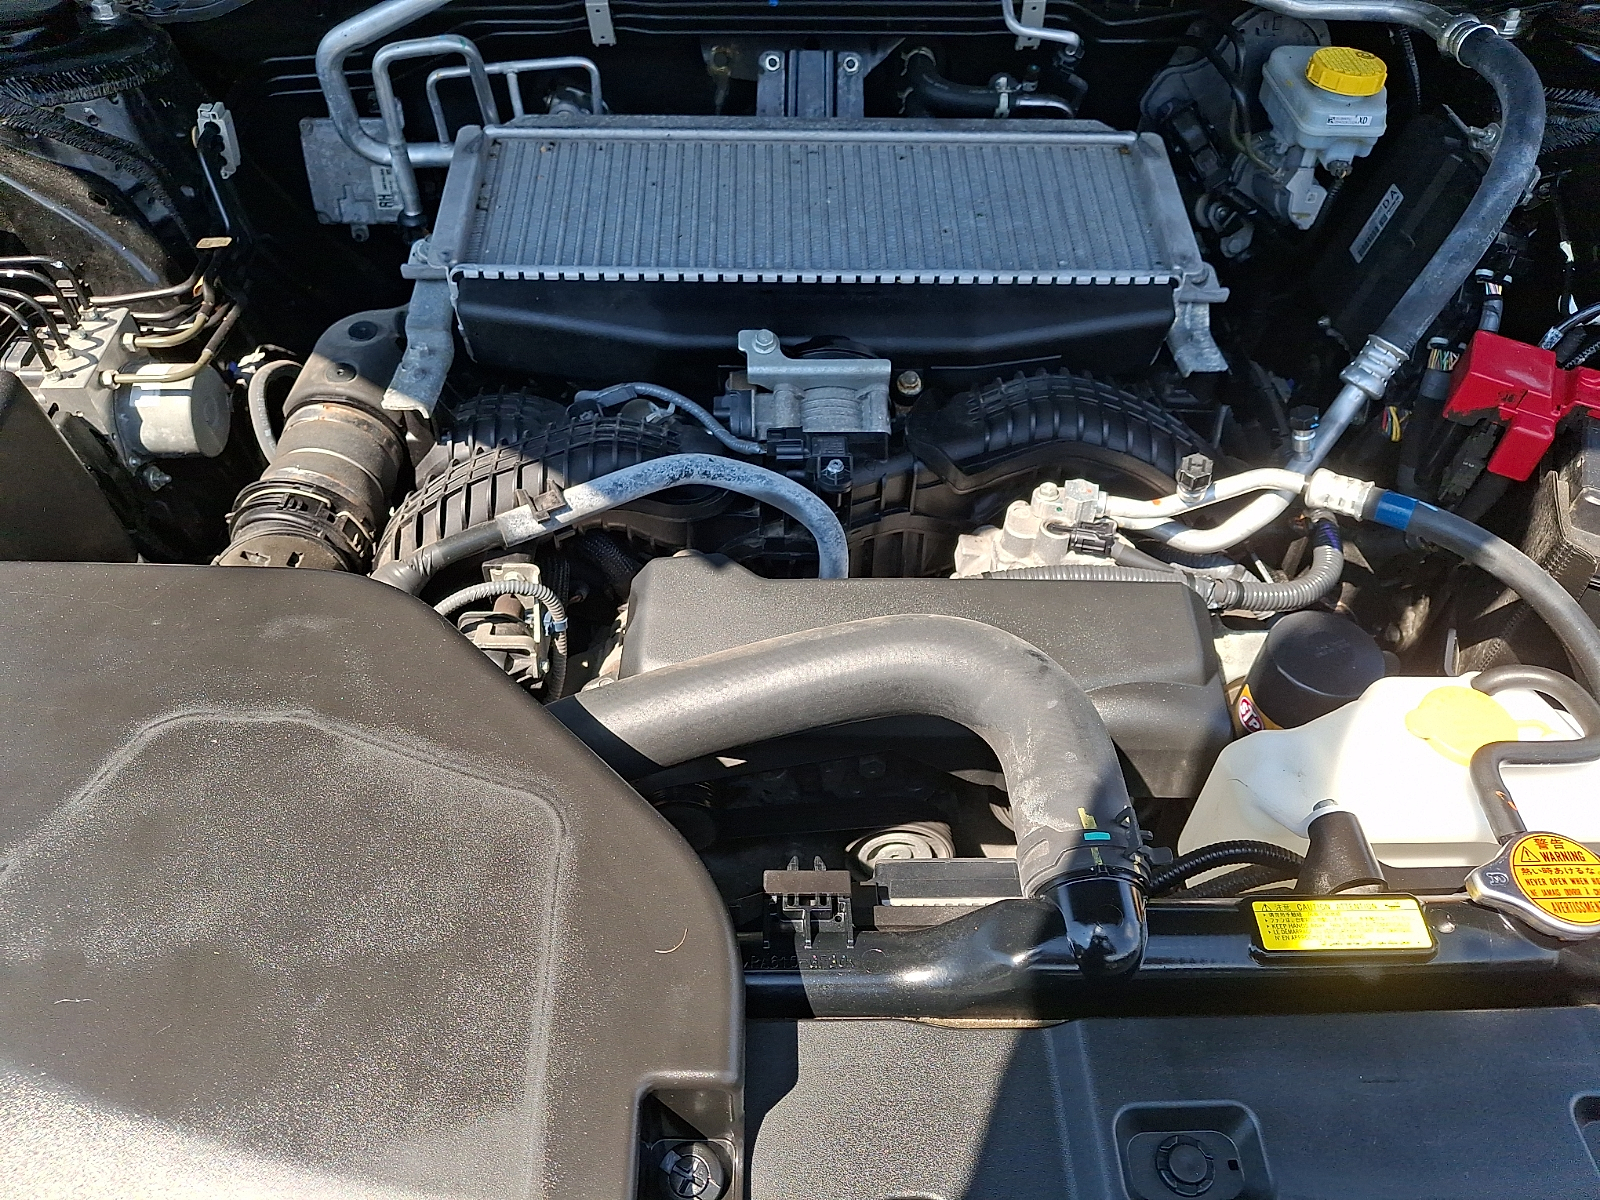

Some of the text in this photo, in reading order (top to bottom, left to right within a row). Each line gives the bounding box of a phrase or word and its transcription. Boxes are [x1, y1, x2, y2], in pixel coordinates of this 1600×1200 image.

[1240, 701, 1260, 729] STP
[1533, 838, 1565, 850] 警告
[1539, 850, 1586, 862] WARNING
[1525, 878, 1547, 886] NEVER
[1549, 877, 1568, 886] OPEN
[1569, 877, 1589, 885] WHEN
[1296, 903, 1331, 911] CAUTION
[1336, 902, 1379, 911] ATTENTION
[1551, 901, 1600, 914] AVERTISSMEN
